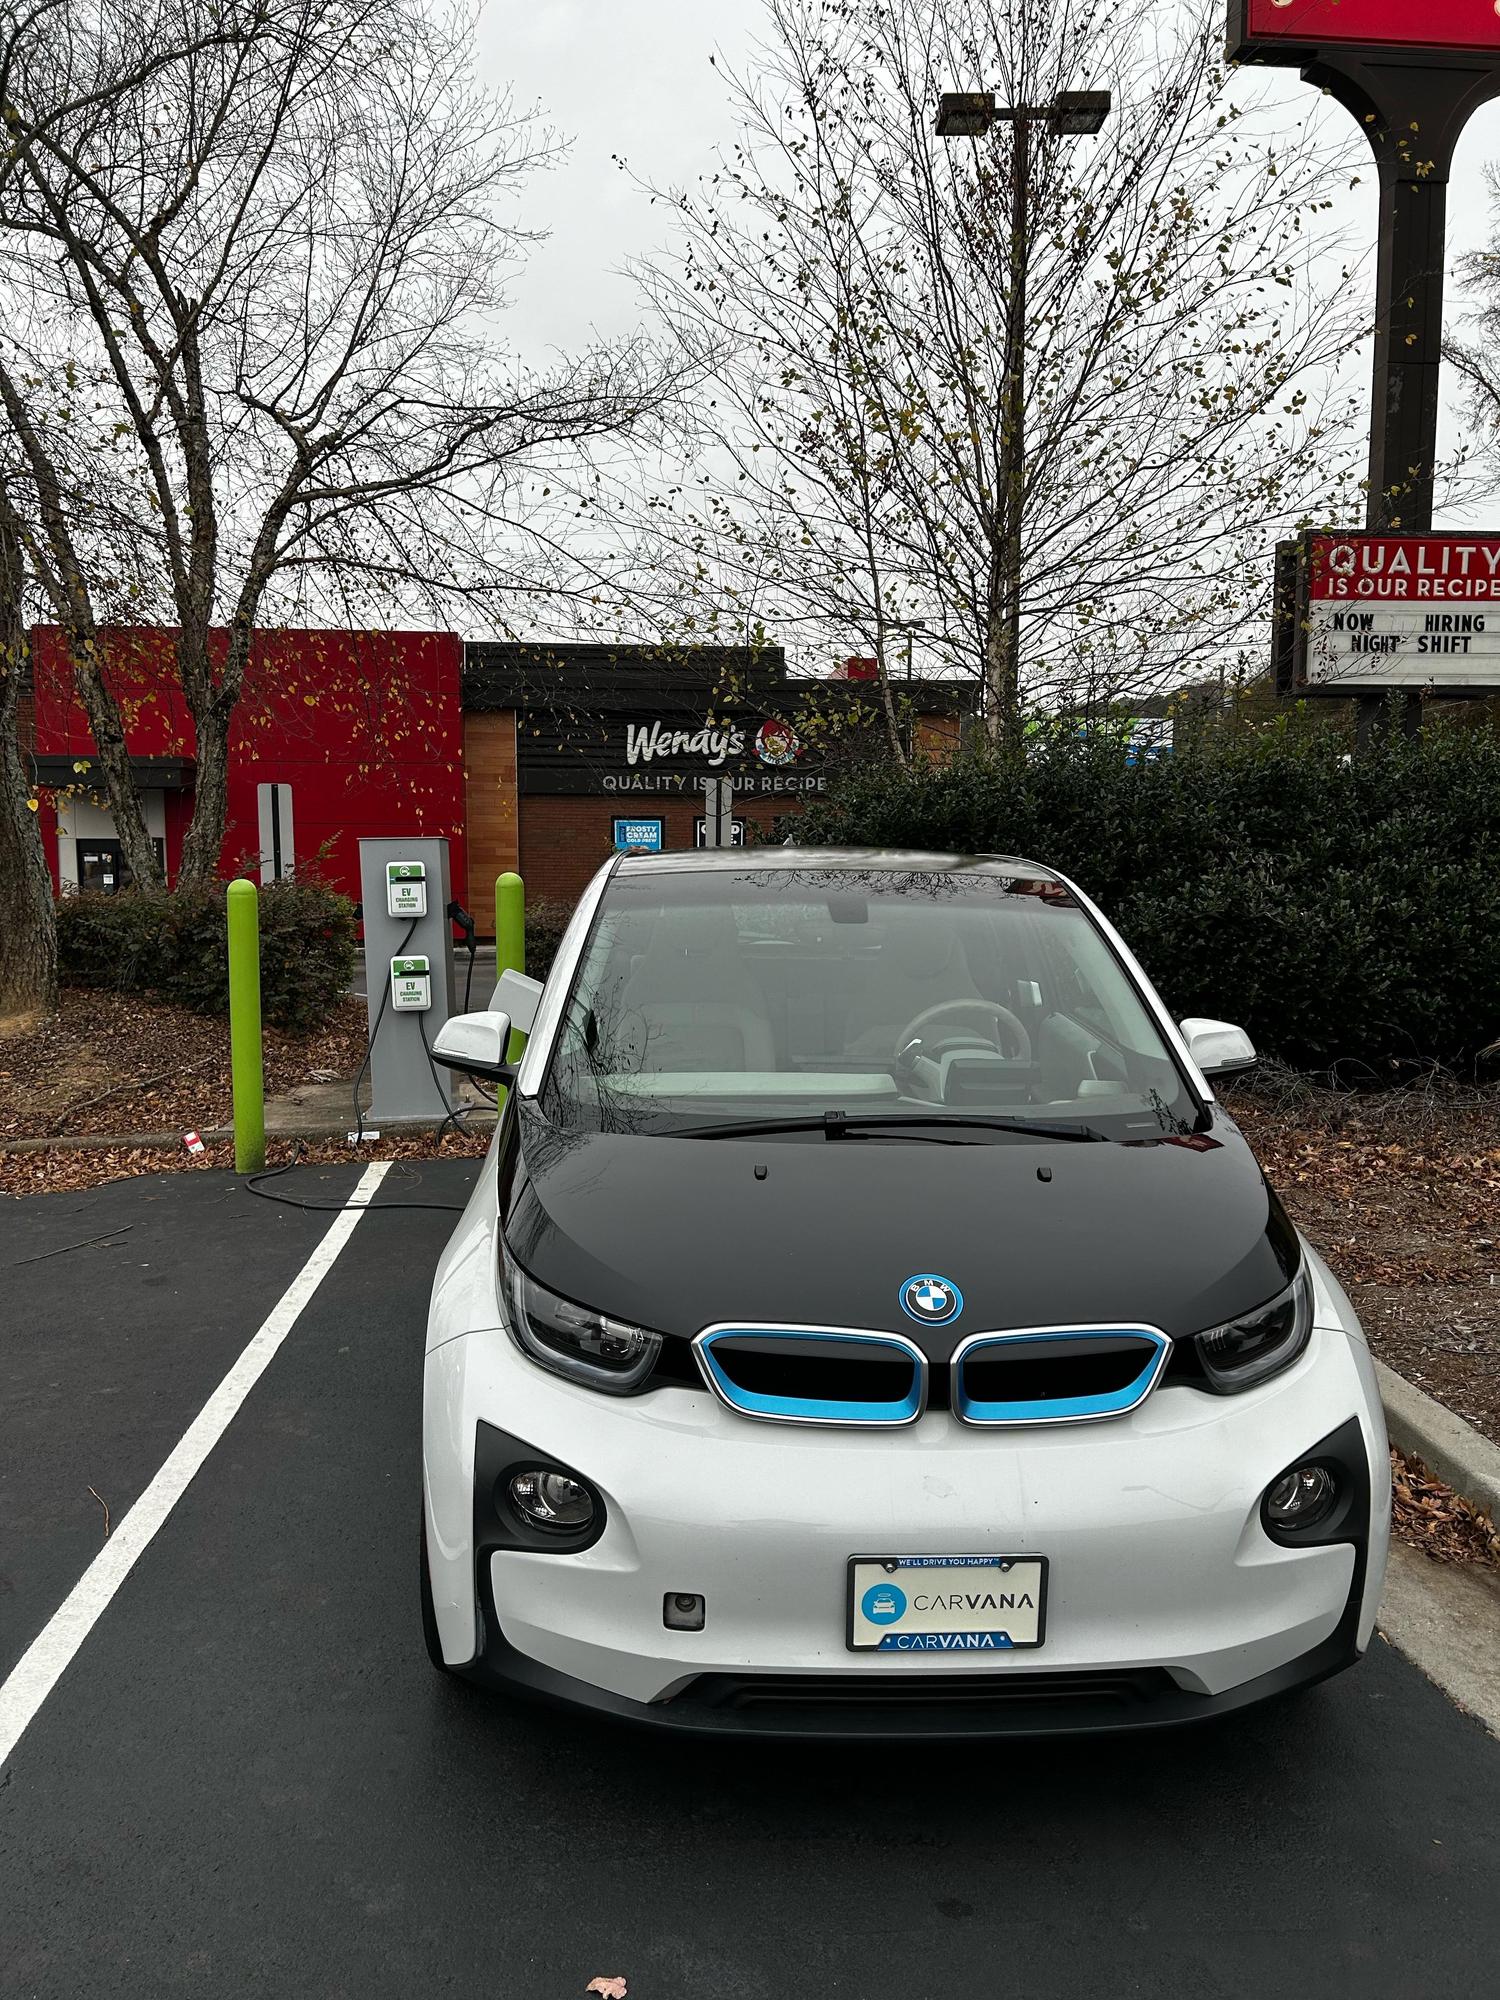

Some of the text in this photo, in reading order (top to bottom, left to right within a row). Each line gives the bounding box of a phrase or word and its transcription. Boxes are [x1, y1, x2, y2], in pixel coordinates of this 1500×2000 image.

[1329, 546, 1500, 575] QUALITY
[1329, 578, 1500, 597] IS OUR RECIPE
[1334, 613, 1485, 632] NOW HIRING
[1351, 634, 1471, 652] NIGHT SHIFT
[626, 720, 746, 766] Wendy's
[602, 775, 687, 791] QUALITY
[761, 776, 827, 792] RECIPE
[401, 888, 412, 896] EV
[406, 982, 416, 990] EV
[910, 1279, 951, 1293] BMW
[913, 1593, 1034, 1610] CARVANA
[897, 1634, 995, 1649] CARVANA
